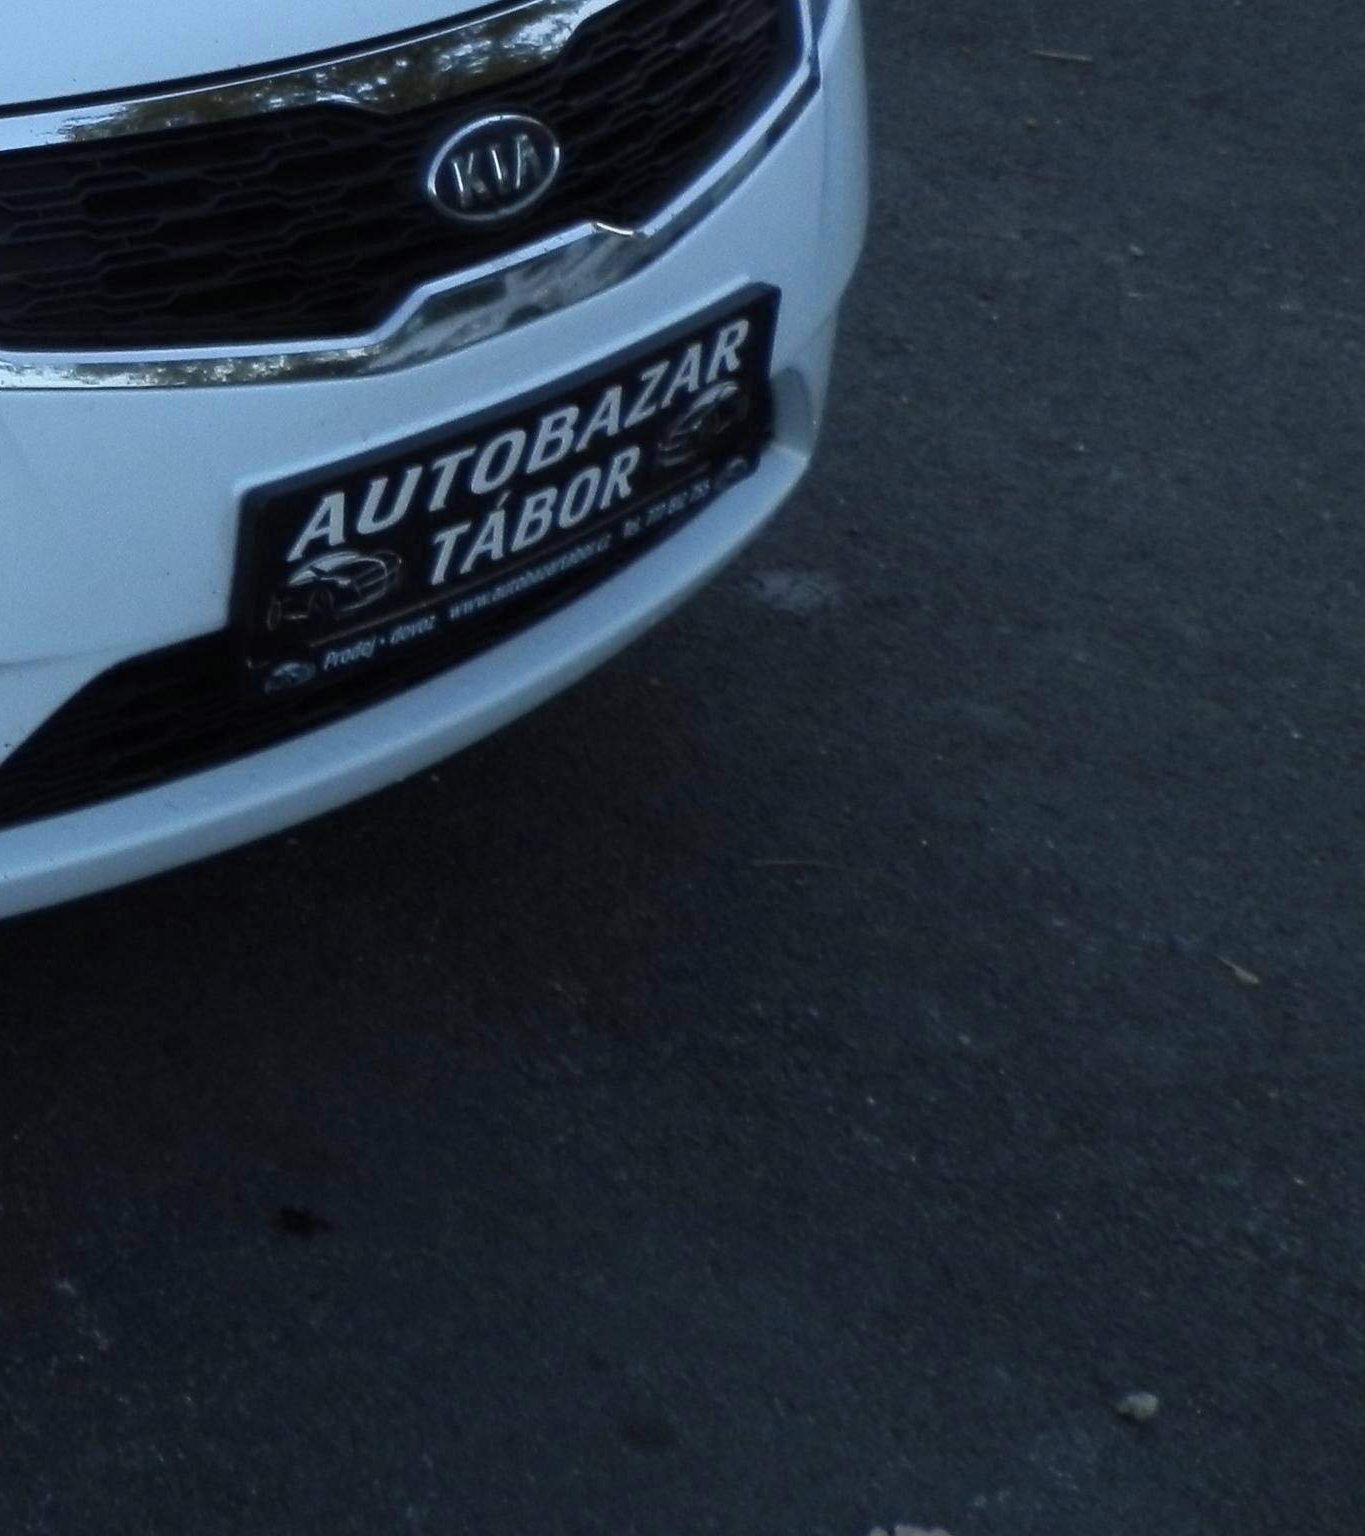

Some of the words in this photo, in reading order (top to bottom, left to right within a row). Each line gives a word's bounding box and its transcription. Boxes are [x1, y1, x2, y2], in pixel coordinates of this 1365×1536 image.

[452, 132, 543, 208] KIA
[286, 317, 749, 561] AUTOBAZAR
[429, 444, 641, 587] TÁBOR
